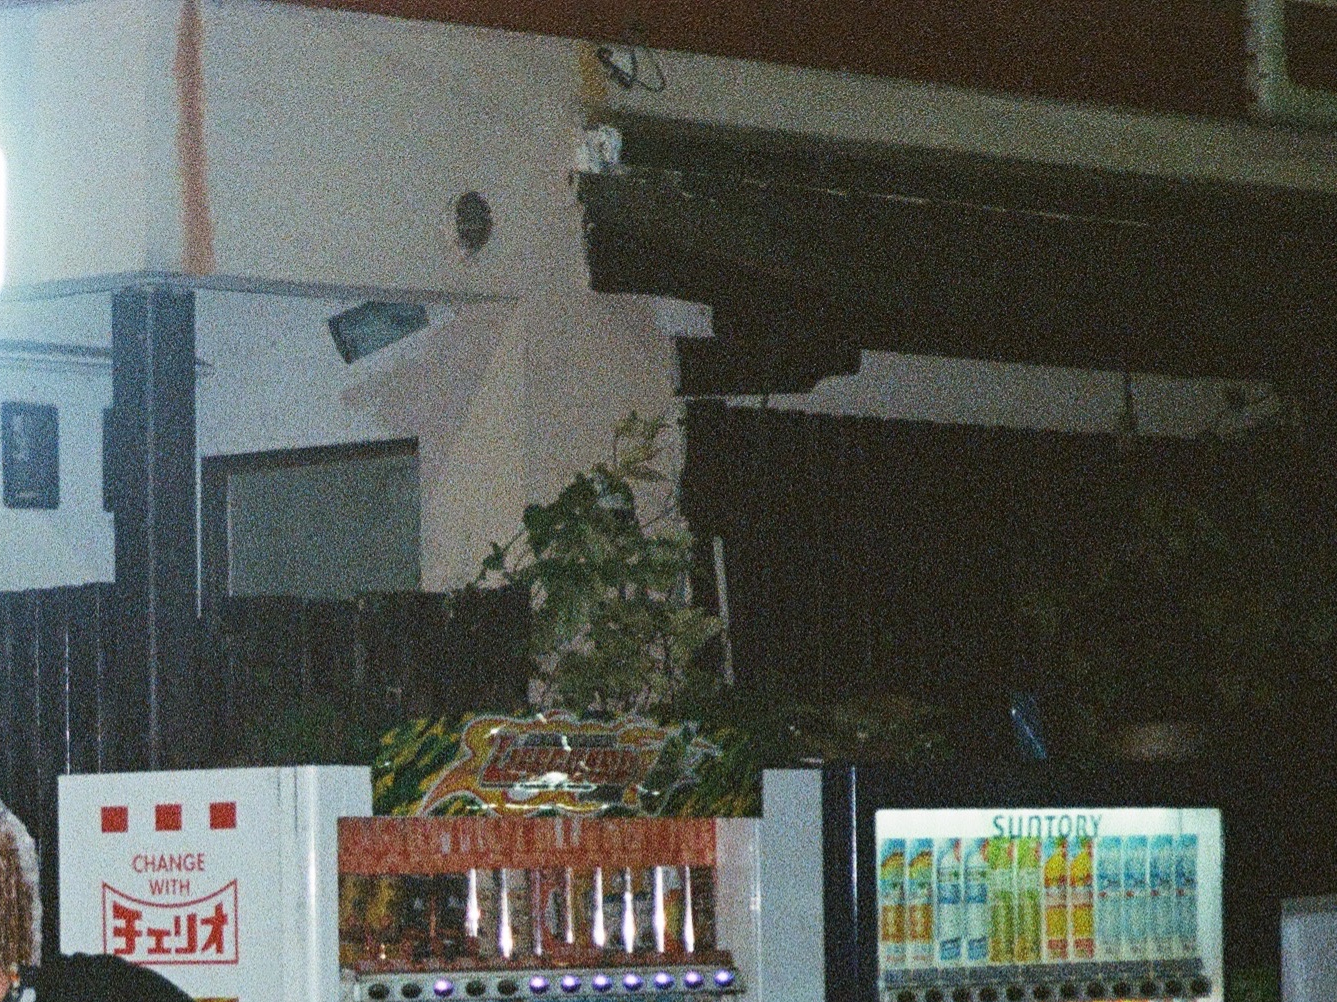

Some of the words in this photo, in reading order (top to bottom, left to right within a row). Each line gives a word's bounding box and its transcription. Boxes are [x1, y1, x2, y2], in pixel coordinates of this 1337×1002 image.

[992, 814, 1103, 838] SUNTORY
[132, 853, 206, 873] CHANGE
[149, 879, 191, 896] WITH
[112, 901, 229, 955] チェリオ
